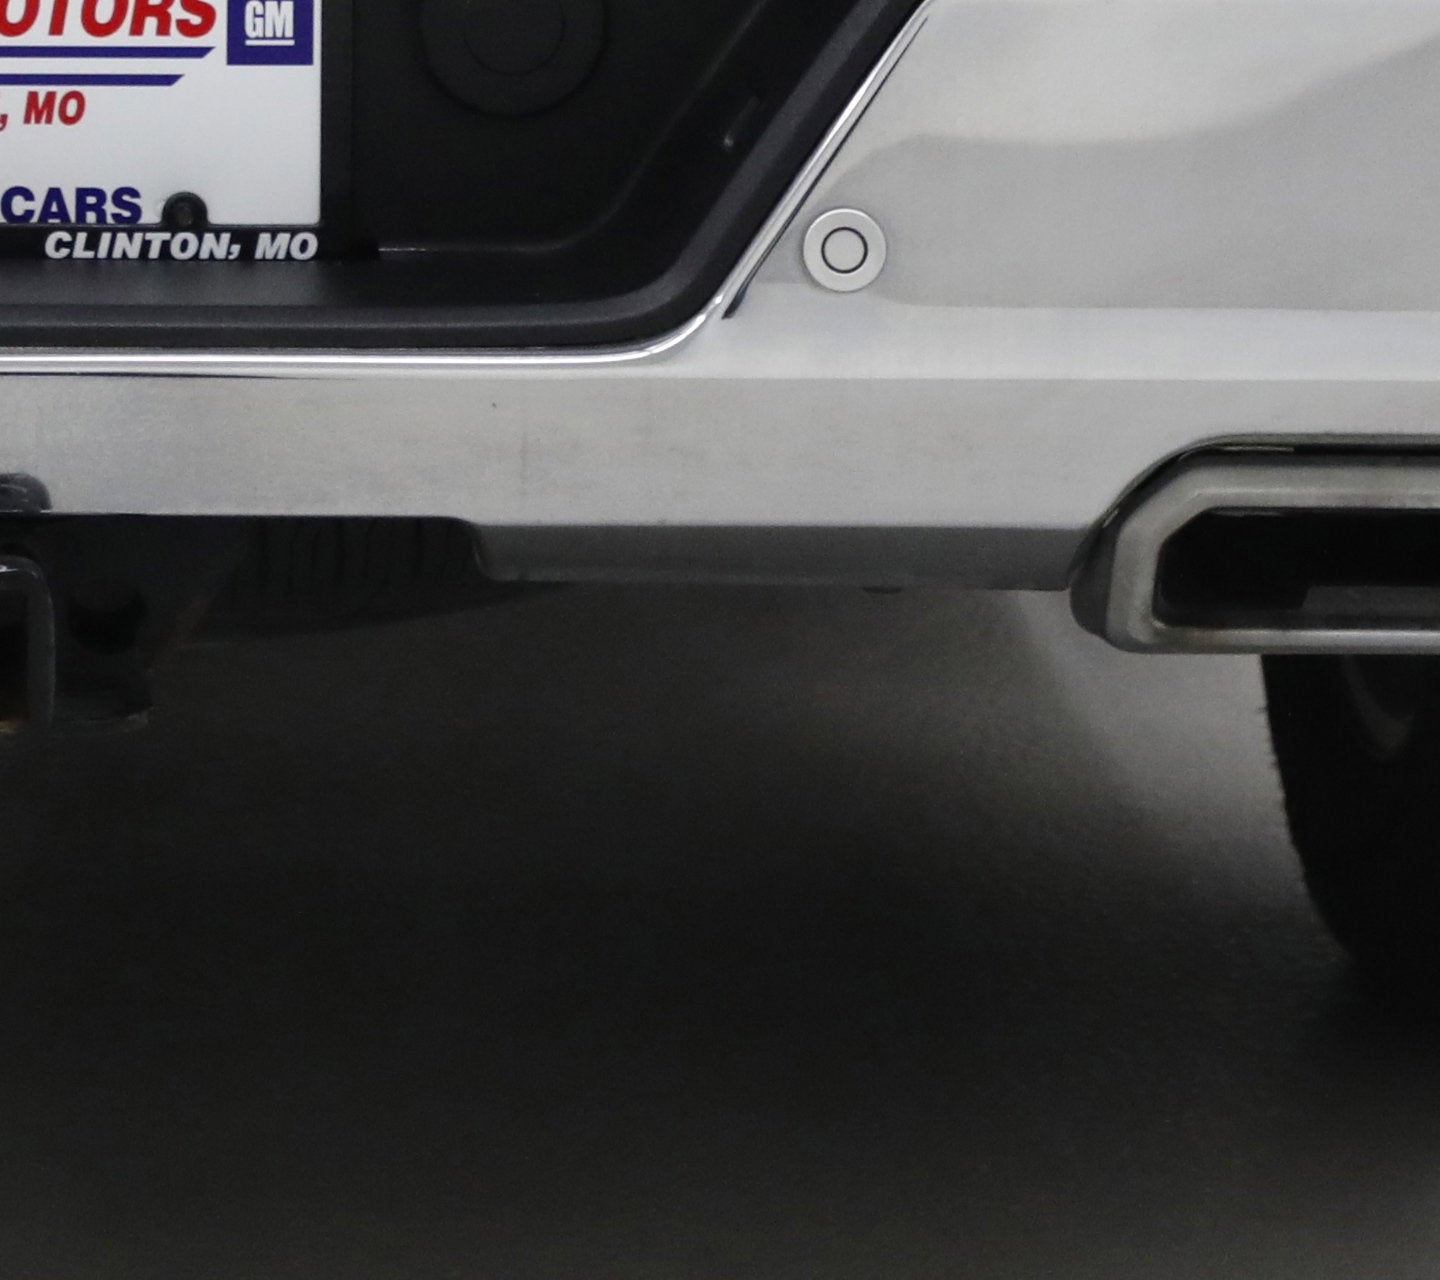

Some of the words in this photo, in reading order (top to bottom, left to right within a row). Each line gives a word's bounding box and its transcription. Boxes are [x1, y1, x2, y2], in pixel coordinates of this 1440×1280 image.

[23, 90, 86, 125] MO
[44, 230, 241, 260] CLINTON,
[254, 232, 318, 261] MO
